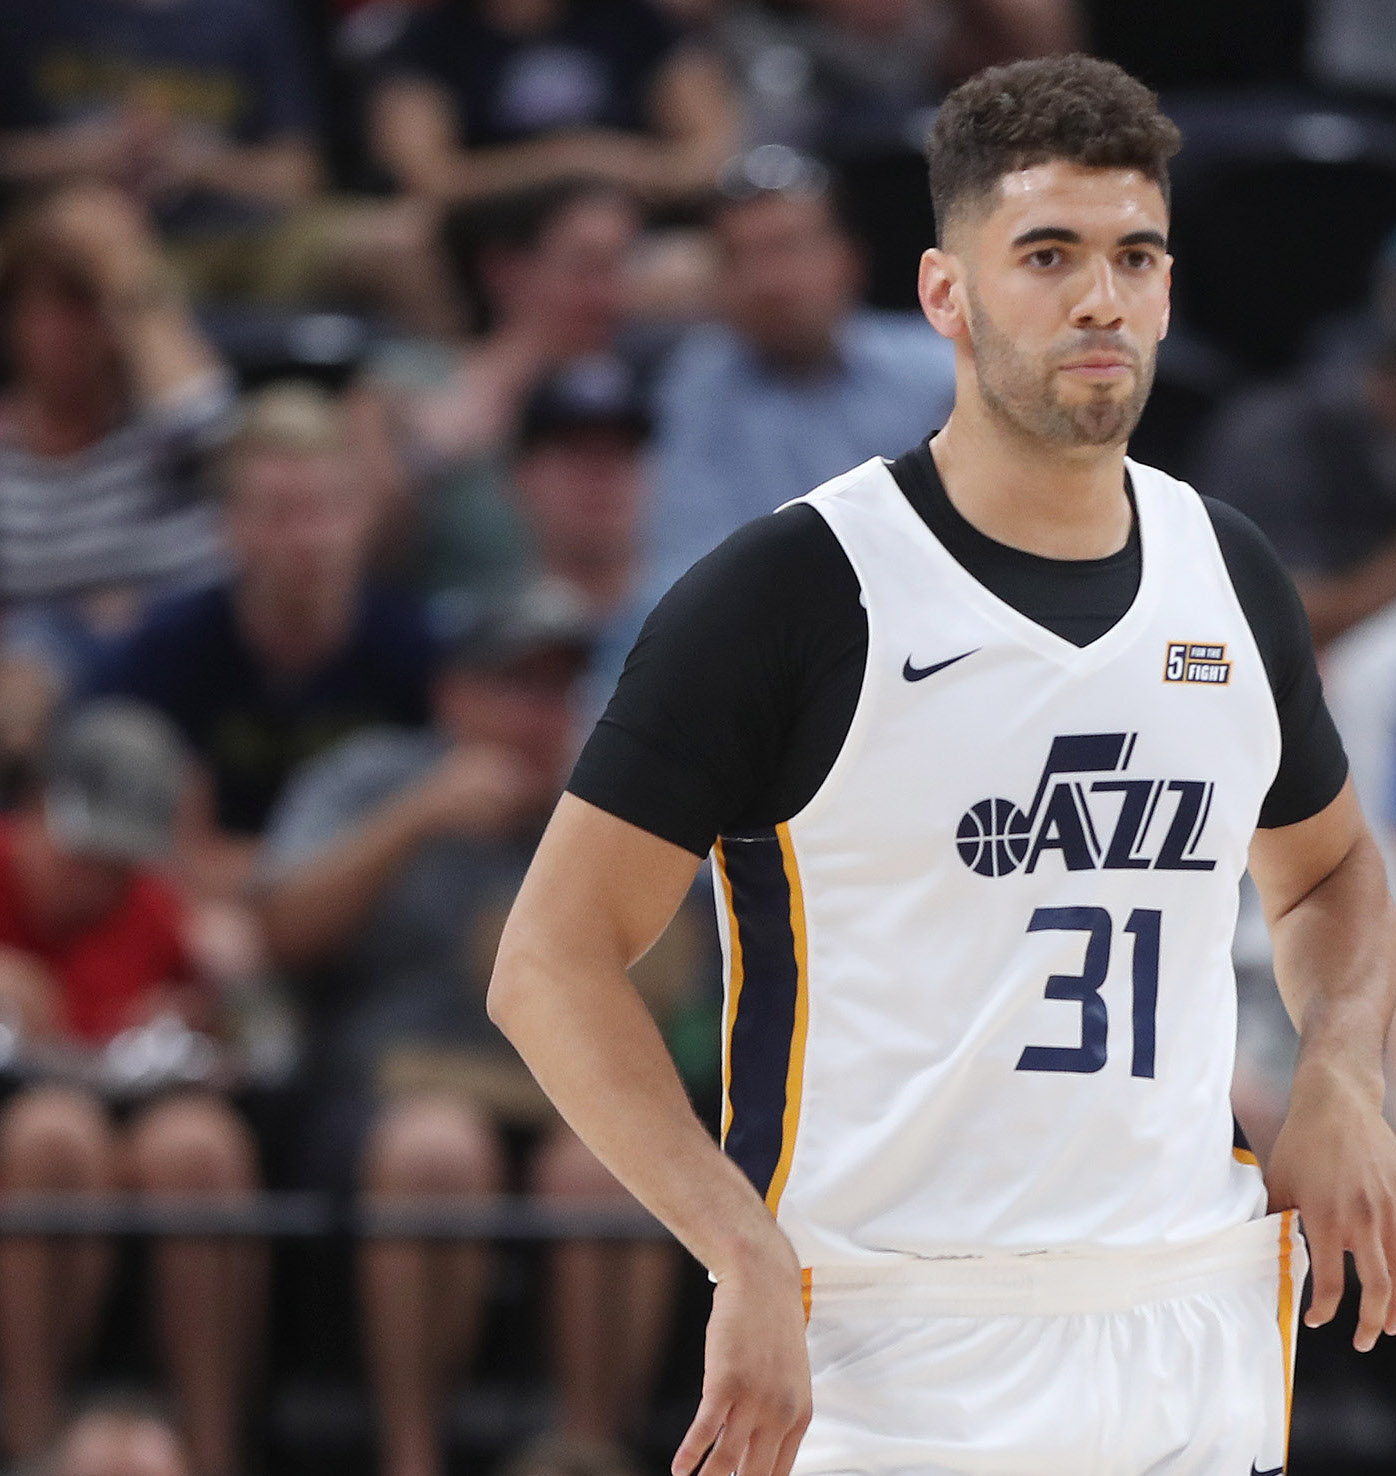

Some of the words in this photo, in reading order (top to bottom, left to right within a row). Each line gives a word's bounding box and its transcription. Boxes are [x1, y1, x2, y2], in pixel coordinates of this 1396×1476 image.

[1166, 645, 1185, 681] 5
[1187, 663, 1228, 682] FIGHT
[956, 732, 1217, 877] JAZZ
[1015, 906, 1162, 1079] 31
